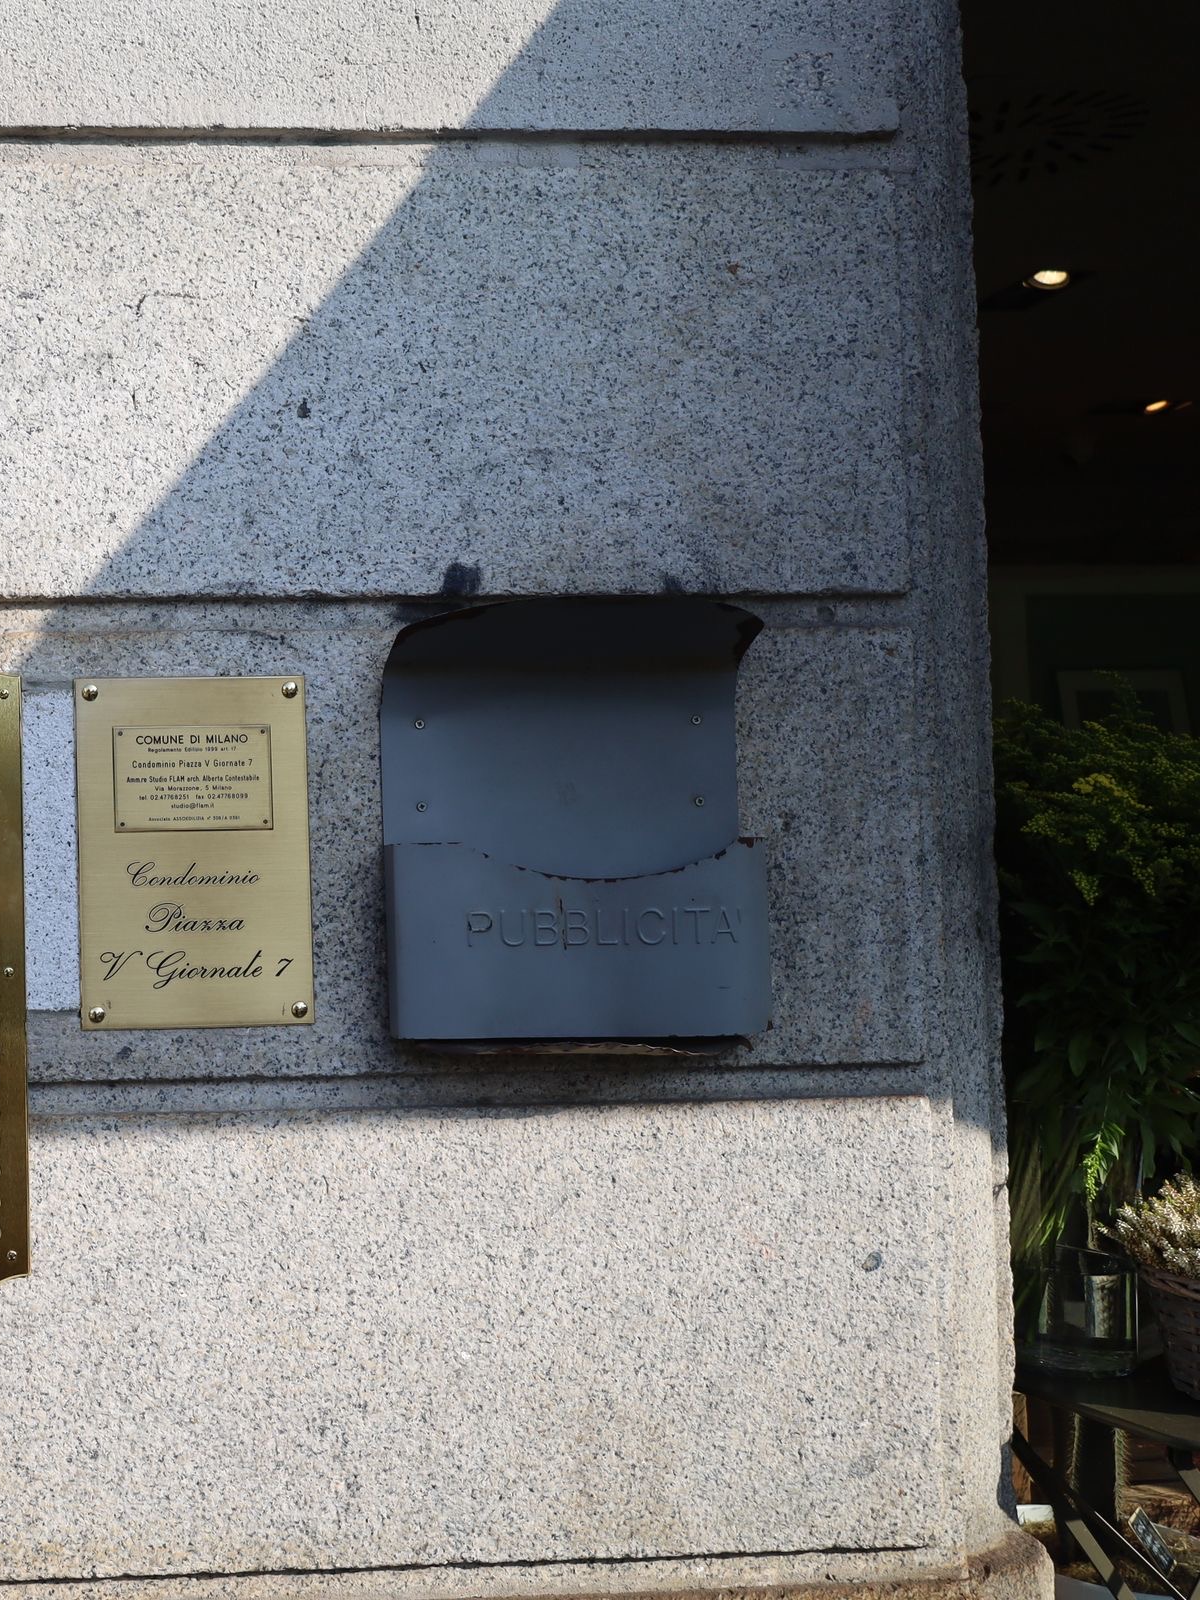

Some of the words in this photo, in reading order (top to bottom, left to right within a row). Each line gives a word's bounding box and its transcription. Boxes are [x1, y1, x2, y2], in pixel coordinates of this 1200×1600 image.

[135, 735, 184, 745] COMUNE
[190, 735, 201, 744] DI
[205, 734, 249, 744] MILANO
[132, 760, 176, 769] Condominio
[178, 760, 202, 768] Piazza
[213, 759, 245, 767] Giornate
[248, 758, 253, 766] 7
[126, 861, 261, 887] Condominio
[144, 902, 245, 933] Piazza
[99, 950, 144, 982] V
[146, 949, 263, 990] Giornate
[274, 957, 294, 977] 7
